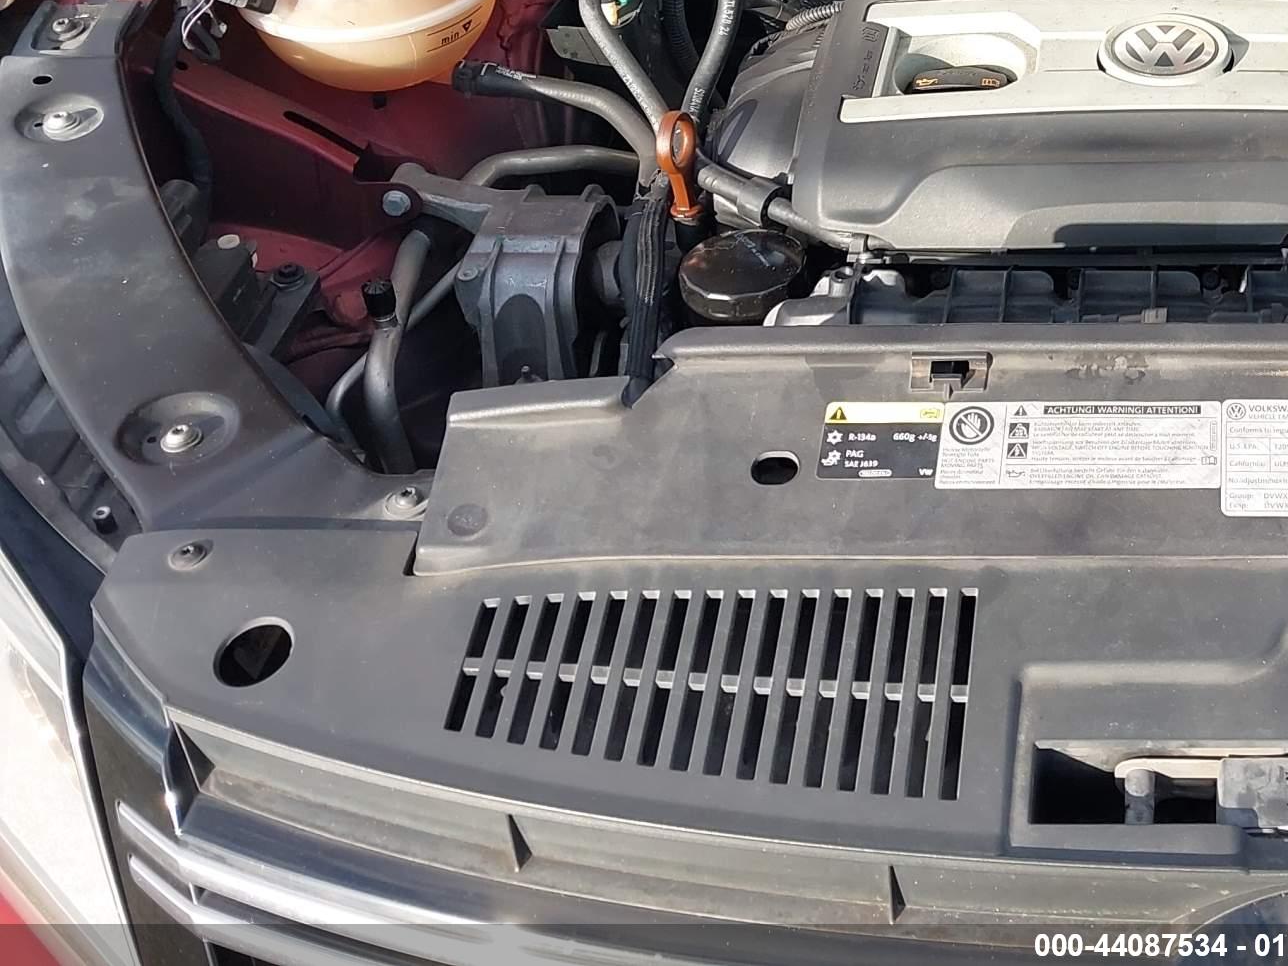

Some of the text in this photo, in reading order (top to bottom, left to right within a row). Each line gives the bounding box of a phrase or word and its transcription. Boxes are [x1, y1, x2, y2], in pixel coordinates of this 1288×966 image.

[441, 31, 461, 47] min
[1146, 406, 1199, 414] ATTENTION!
[848, 433, 877, 441] R-134a
[892, 432, 916, 442] 660g
[845, 449, 864, 458] PAG
[844, 460, 859, 468] SAE
[918, 468, 934, 476] VW
